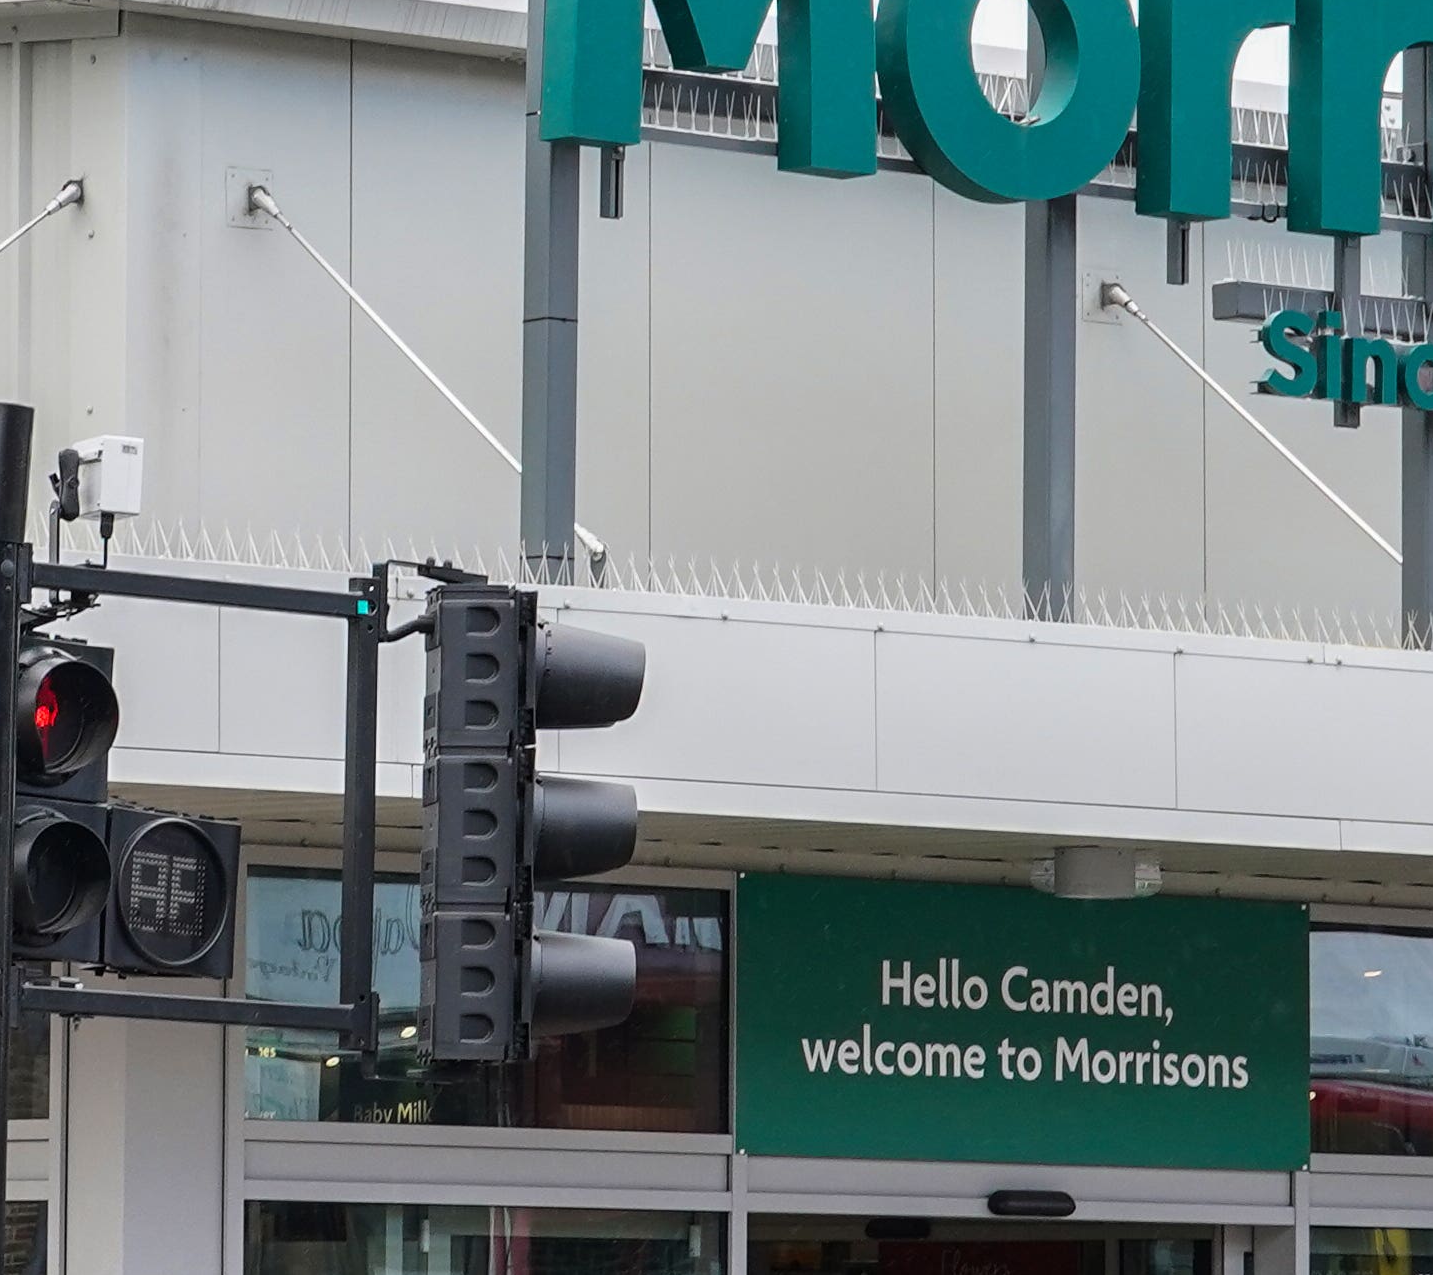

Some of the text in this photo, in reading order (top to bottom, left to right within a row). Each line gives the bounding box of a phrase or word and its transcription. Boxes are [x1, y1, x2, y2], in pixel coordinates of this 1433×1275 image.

[881, 957, 1174, 1026] Hello Camden,
[801, 1023, 1249, 1089] welcome to Morrisons
[396, 1099, 433, 1123] Milk
